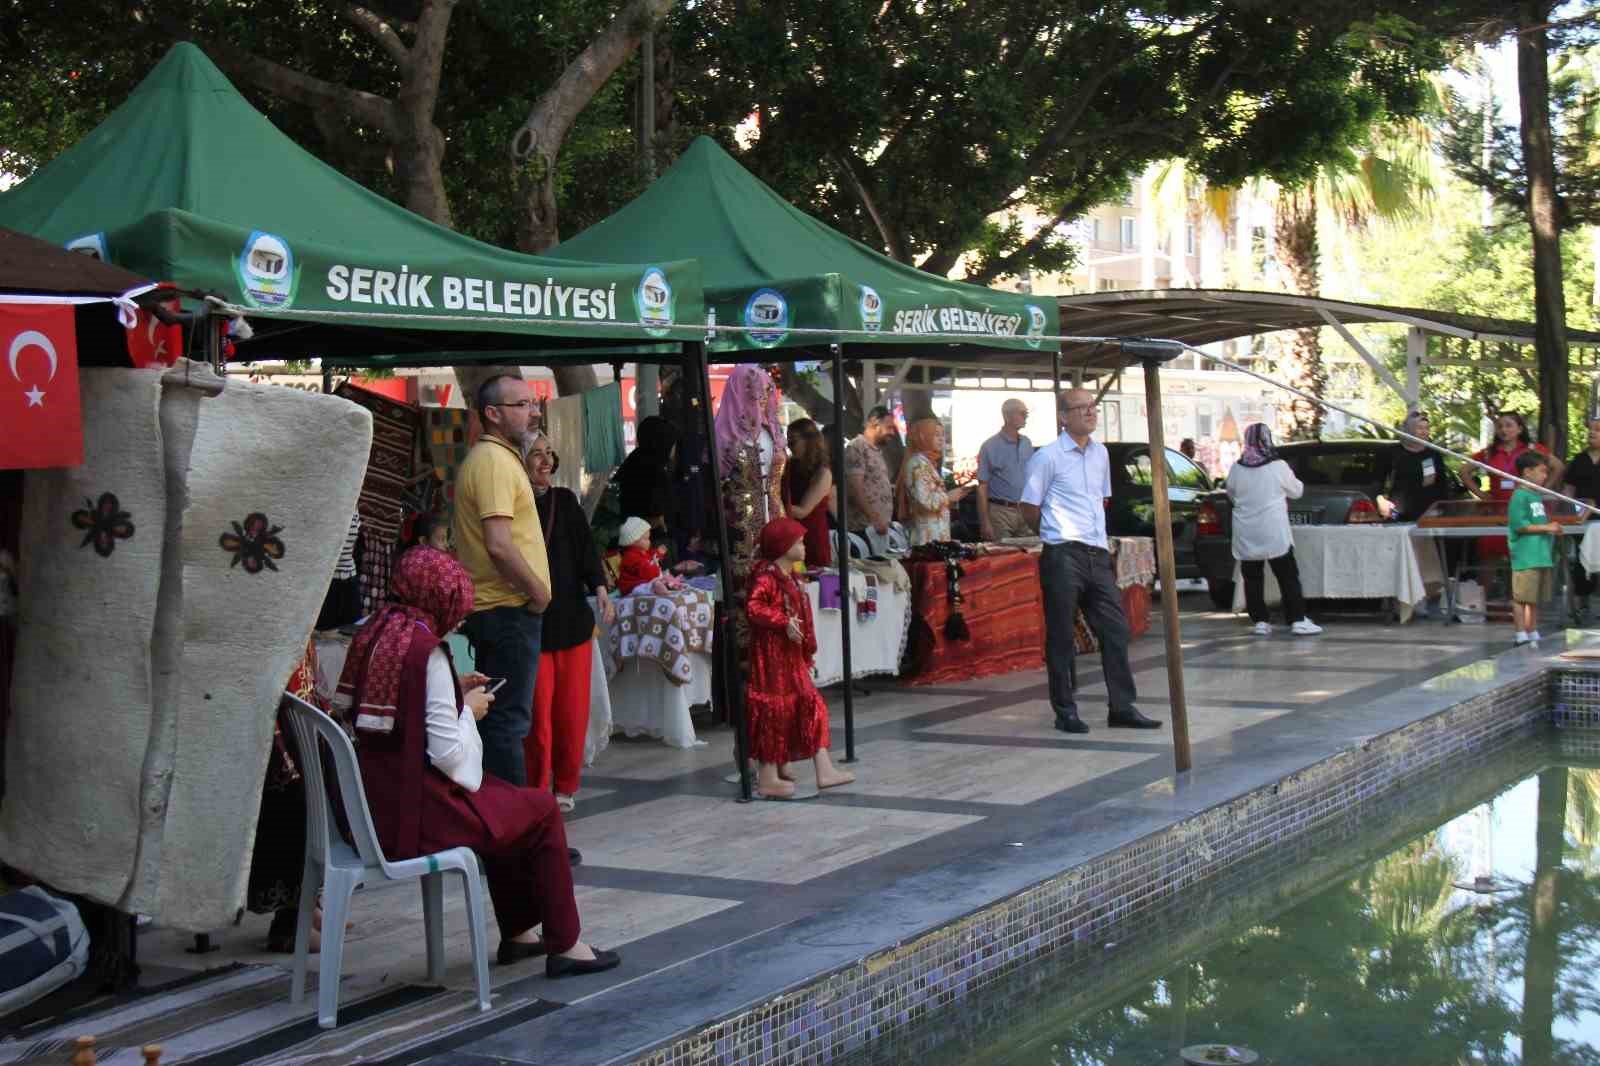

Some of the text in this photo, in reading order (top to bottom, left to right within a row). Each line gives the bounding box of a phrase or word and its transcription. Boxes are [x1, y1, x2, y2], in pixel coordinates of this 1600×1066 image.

[326, 265, 616, 319] SERİK BELEDİYESİ
[893, 304, 938, 333] SERİK
